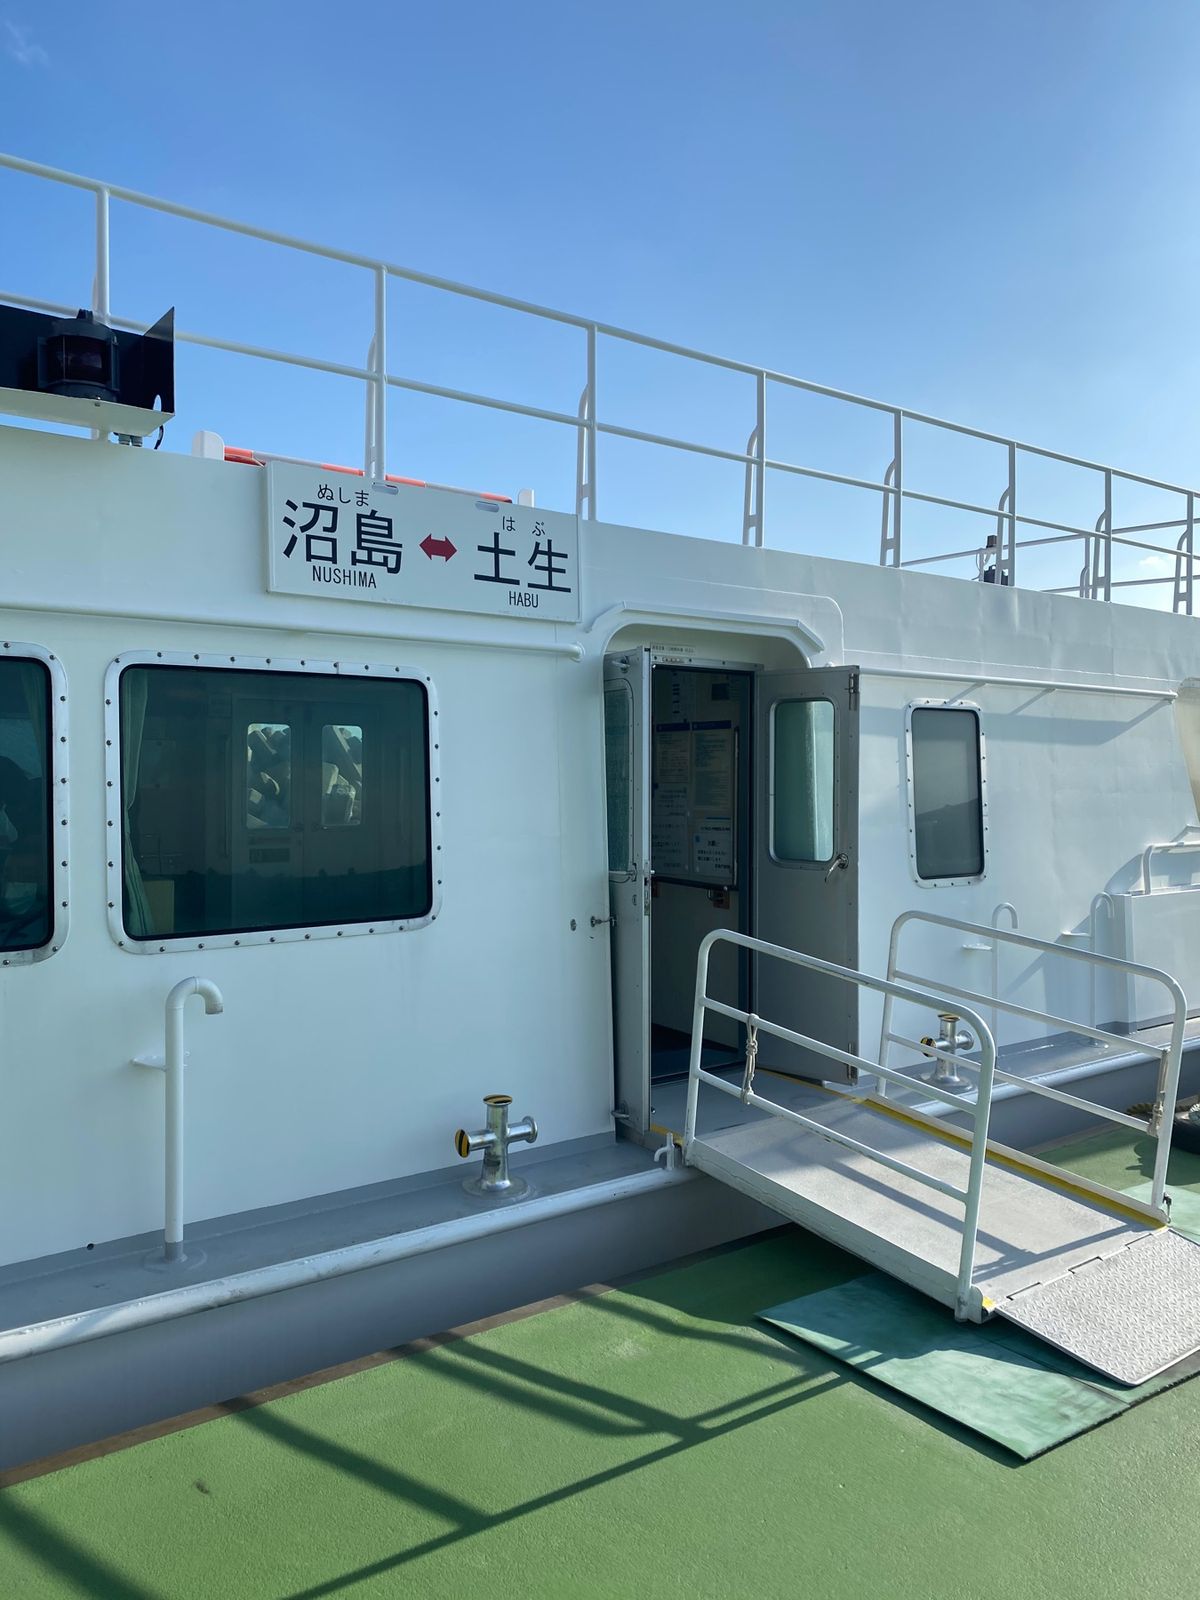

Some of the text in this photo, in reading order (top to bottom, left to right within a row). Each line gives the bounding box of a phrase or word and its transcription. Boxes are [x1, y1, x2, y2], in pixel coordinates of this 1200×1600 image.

[317, 483, 370, 507] ぬしま
[282, 497, 403, 574] 沼島
[473, 531, 572, 593] 土生
[312, 564, 377, 588] NUSHIMA
[508, 591, 539, 608] HABU
